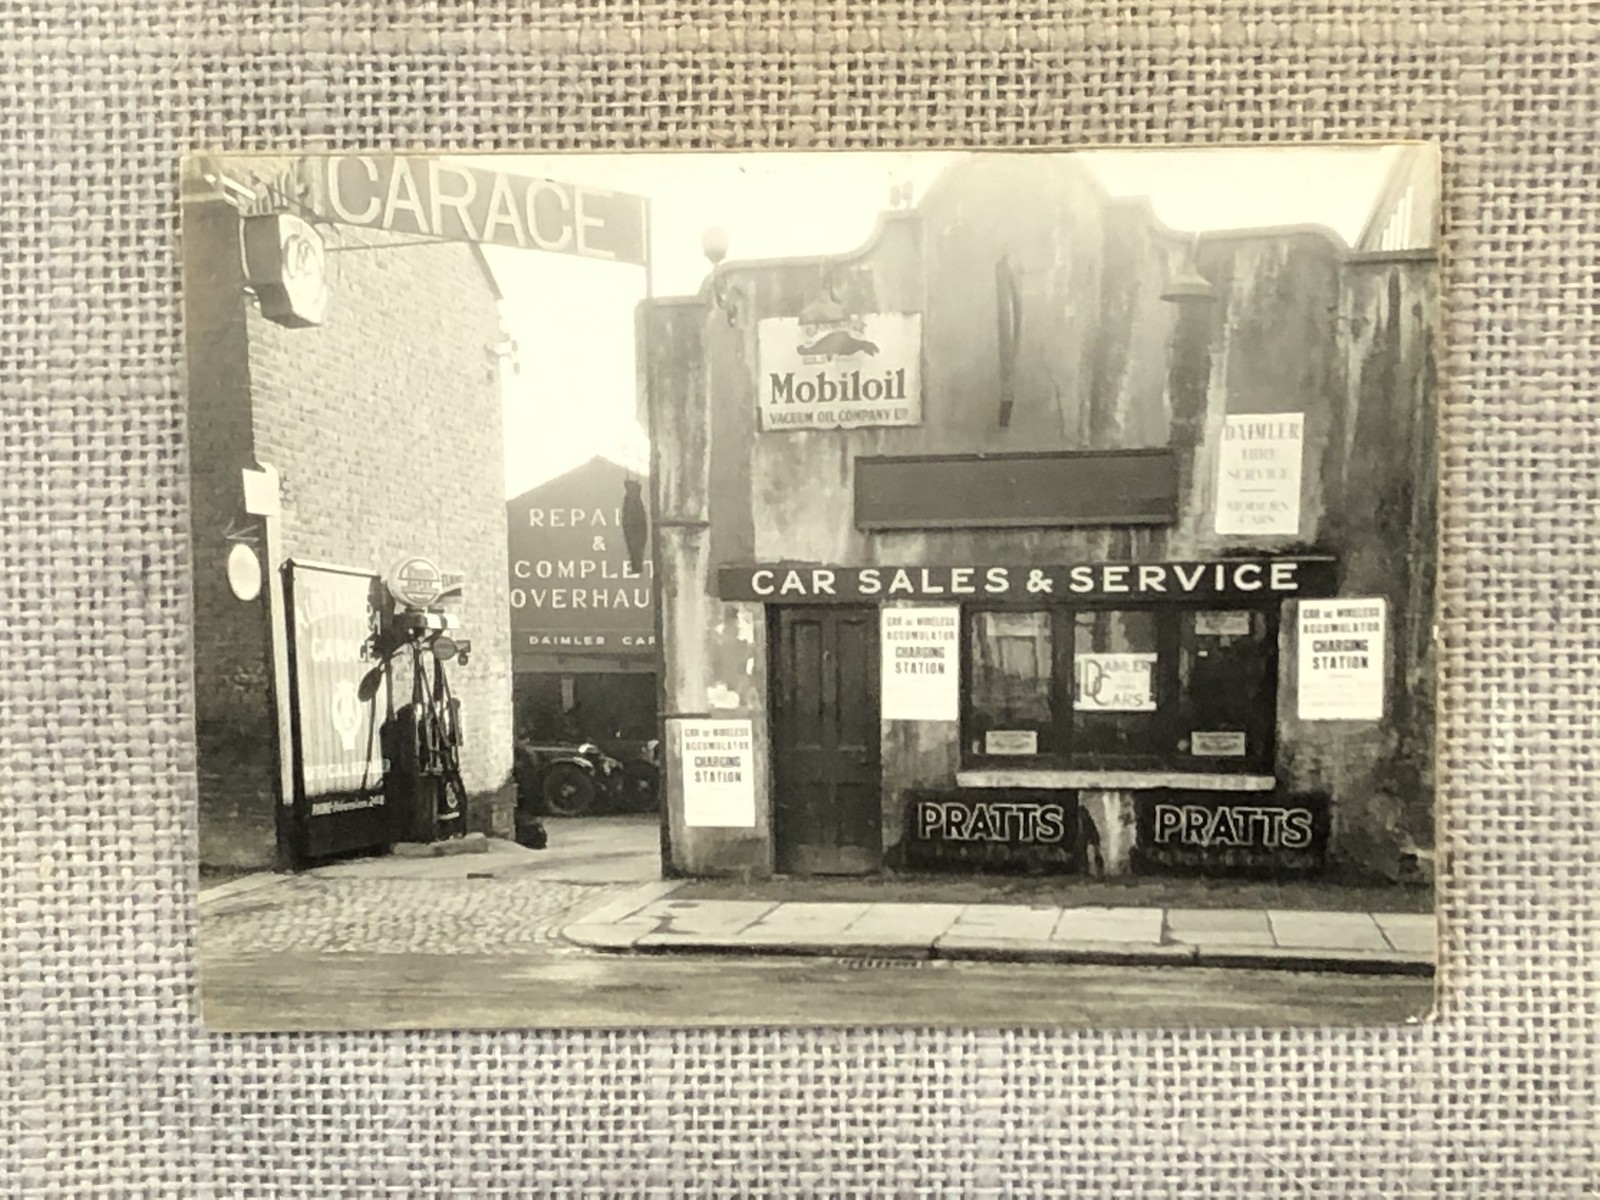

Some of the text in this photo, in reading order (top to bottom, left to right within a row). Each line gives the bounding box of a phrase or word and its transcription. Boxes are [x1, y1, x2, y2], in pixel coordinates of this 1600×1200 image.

[770, 367, 906, 404] Mobiloil
[770, 412, 813, 424] VACUUM
[817, 410, 836, 423] OIL
[838, 409, 890, 422] COMPANY
[1224, 422, 1300, 441] DAIMLER
[529, 508, 620, 527] REPAI
[592, 535, 606, 551] &
[514, 560, 653, 579] COMPLET
[752, 563, 1298, 595] CAR SALES & SERVICE
[510, 588, 650, 609] OVERHAU
[1302, 622, 1380, 633] ACCUMULATOR
[529, 636, 655, 645] DAIMLER CAR
[1312, 639, 1369, 652] CHARGING
[895, 646, 945, 658] CHARGING
[895, 662, 945, 674] STATION
[1312, 656, 1369, 669] STATION
[694, 756, 741, 768] CHARGING
[694, 771, 742, 782] STATION
[918, 801, 1064, 841] PRATTS
[1154, 804, 1312, 847] PRATTS
